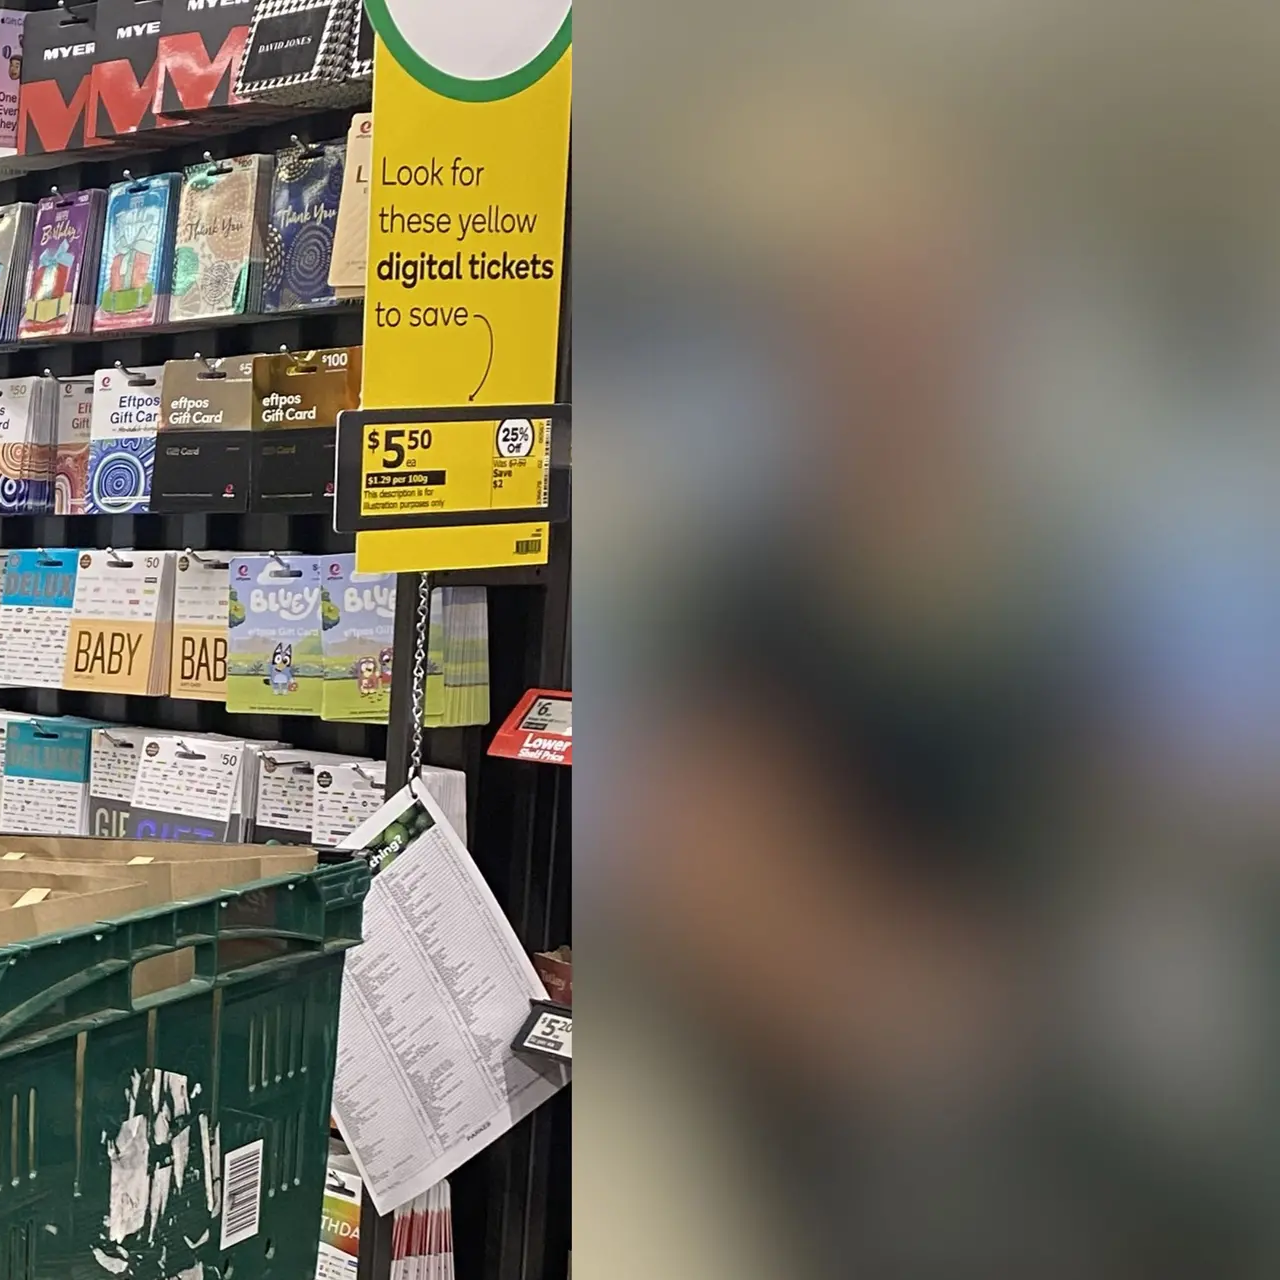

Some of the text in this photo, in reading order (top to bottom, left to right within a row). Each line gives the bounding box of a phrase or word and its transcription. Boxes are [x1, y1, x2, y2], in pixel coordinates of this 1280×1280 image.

[116, 21, 161, 39] MYE
[43, 42, 96, 61] MYER
[258, 36, 312, 53] DAVID JONES
[381, 156, 485, 187] Look for
[276, 203, 338, 229] Thank You
[379, 205, 537, 241] these yellow
[40, 219, 81, 246] Birthday
[185, 221, 218, 240] Thank
[221, 218, 243, 237] You
[376, 252, 554, 289] digital tickets
[375, 302, 469, 328] to save
[321, 352, 348, 367] $100
[240, 363, 252, 375] $5
[118, 395, 161, 410] Eftpos
[171, 397, 210, 413] eftpos
[262, 393, 302, 408] eftpos
[110, 410, 157, 424] Gift Car
[169, 410, 223, 425] Gift Card
[262, 407, 316, 423] Gift Card
[502, 427, 529, 443] 25%
[507, 443, 522, 454] Off
[406, 459, 417, 468] ea
[367, 475, 392, 485] $1.29
[392, 475, 406, 486] per
[493, 469, 513, 478] Save
[493, 479, 504, 489] $2
[379, 488, 416, 500] description
[423, 487, 434, 497] for
[400, 500, 430, 511] purposes
[431, 499, 446, 510] only
[5, 573, 75, 598] DELUX
[344, 585, 396, 618] BLU
[73, 630, 143, 676] BABY
[180, 636, 228, 682] BAB
[523, 733, 572, 752] Lower
[541, 750, 565, 762] Price
[94, 807, 131, 837] GIF
